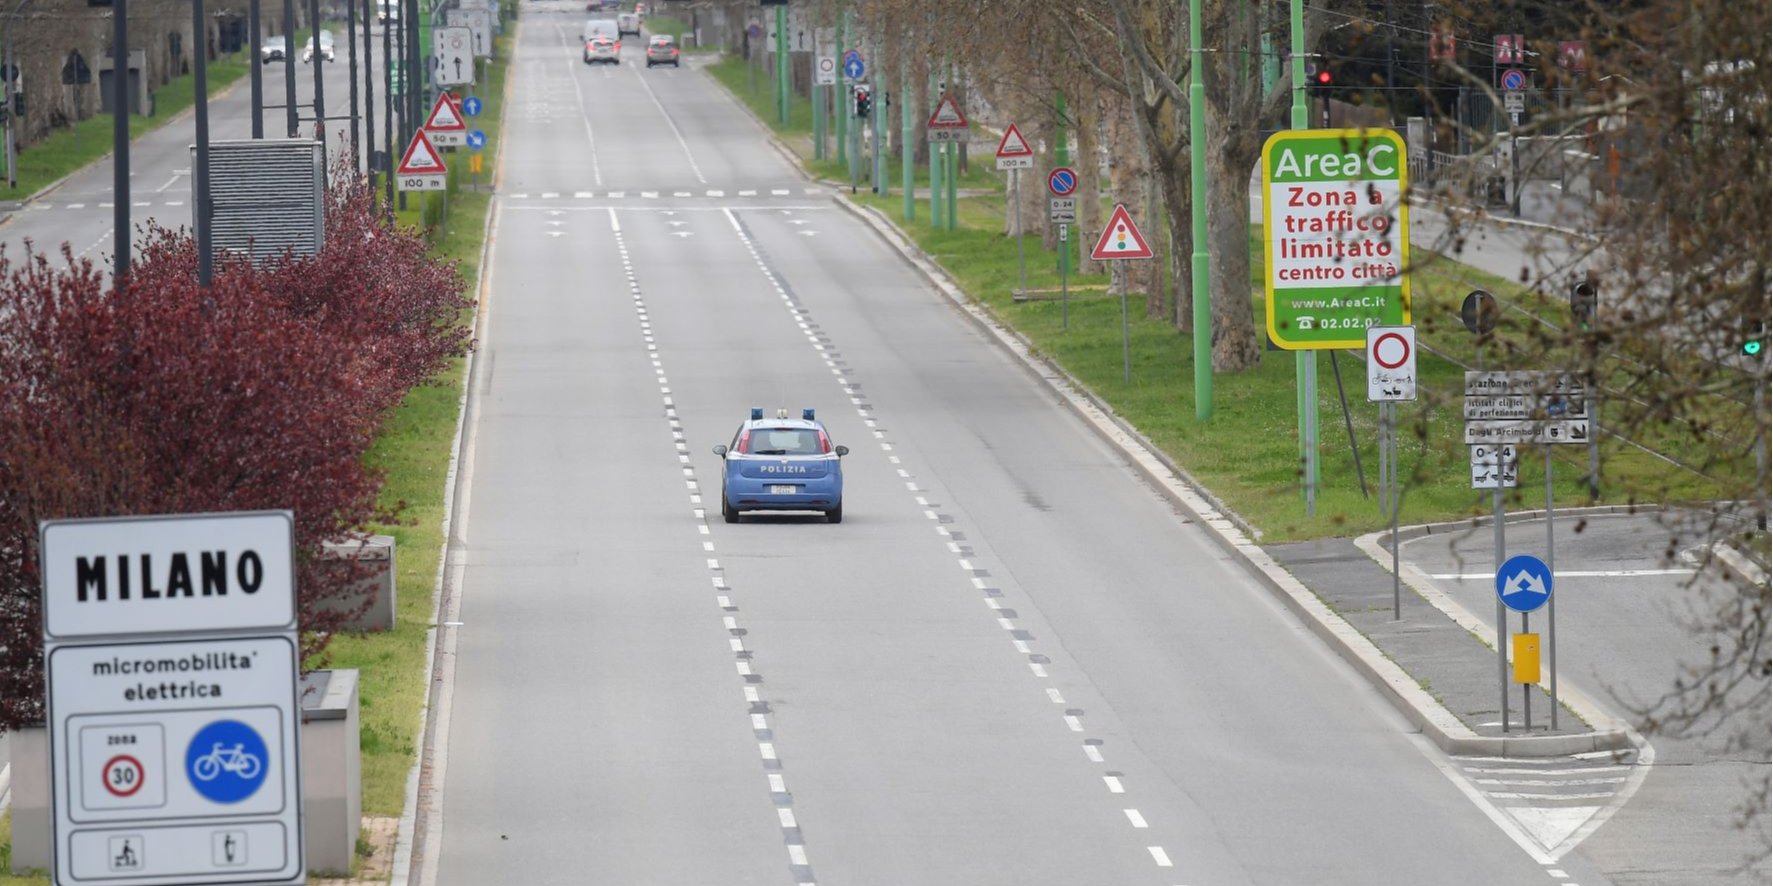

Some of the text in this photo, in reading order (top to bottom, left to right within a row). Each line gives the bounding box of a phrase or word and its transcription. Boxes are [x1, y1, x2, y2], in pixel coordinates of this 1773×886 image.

[433, 135, 446, 143] 50
[937, 131, 949, 140] 50
[1002, 159, 1017, 167] 100
[404, 179, 440, 187] 100 m
[1288, 187, 1382, 207] Zona a
[1285, 211, 1387, 233] traffico
[1281, 237, 1392, 259] limitato
[1279, 262, 1397, 280] centro città
[1291, 296, 1386, 309] www.AreaC.it
[1321, 318, 1382, 329] 02.02.02
[1467, 378, 1508, 388] azione
[1468, 409, 1476, 417] di
[1496, 427, 1545, 436] Arcimbodi
[760, 465, 806, 473] POLIZIA
[76, 549, 264, 602] MILANO
[124, 680, 222, 702] elettrica
[107, 734, 137, 746] zona
[112, 766, 134, 785] 30
